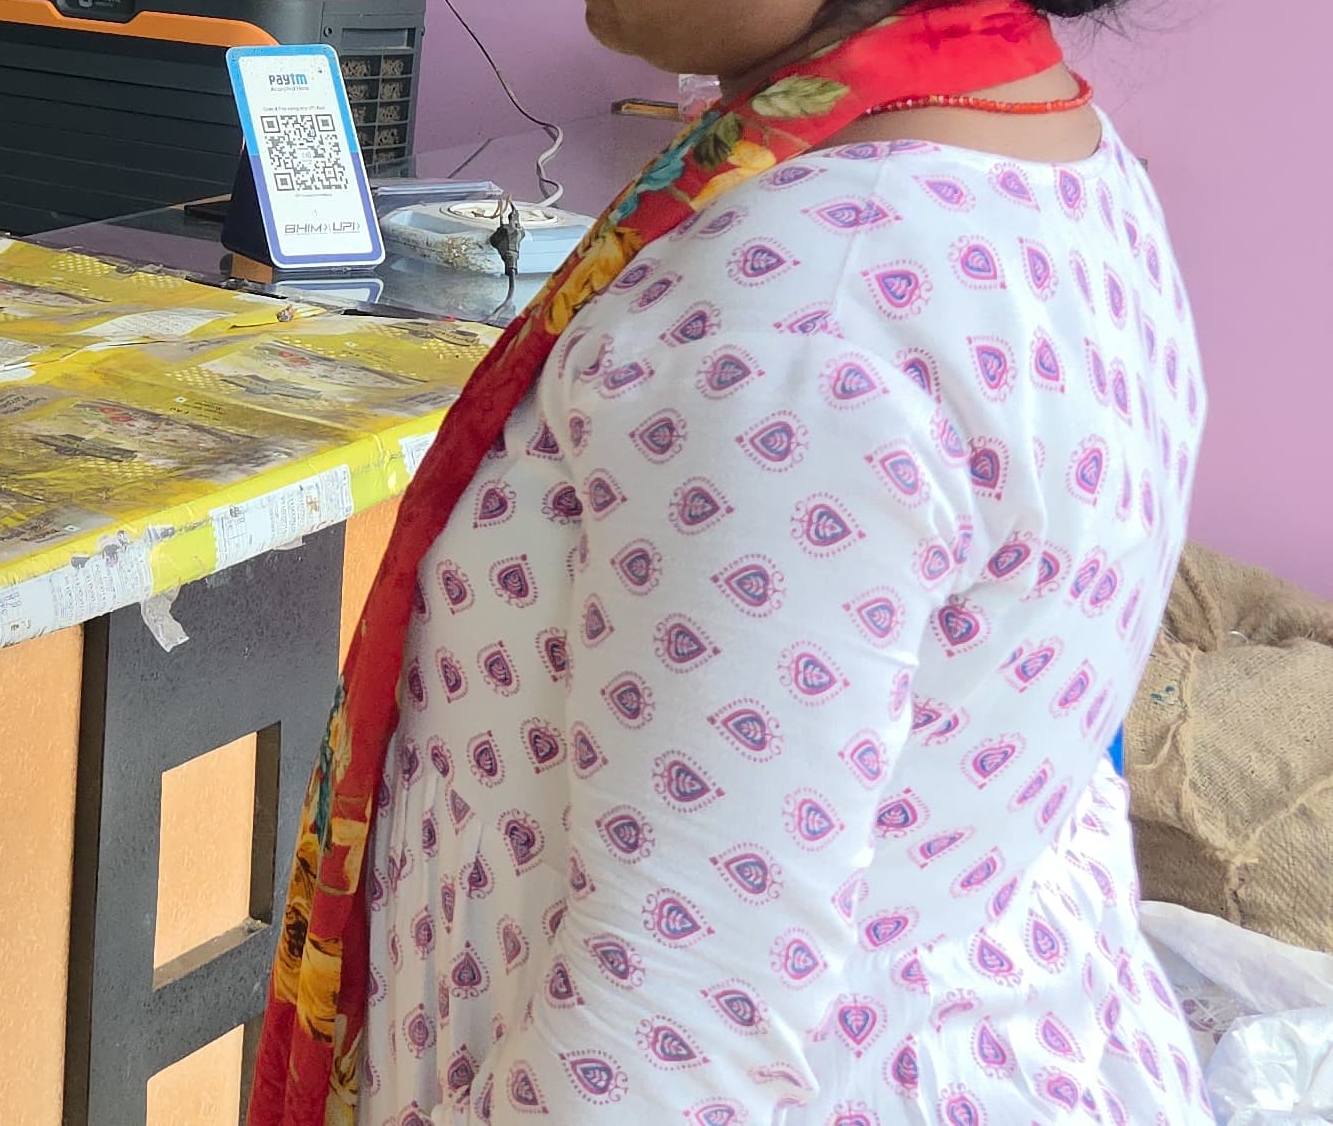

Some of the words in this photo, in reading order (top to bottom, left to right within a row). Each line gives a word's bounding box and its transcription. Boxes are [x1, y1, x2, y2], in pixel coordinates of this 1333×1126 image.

[269, 72, 308, 88] paytm
[284, 222, 323, 234] BHIM
[332, 221, 356, 232] UPI
